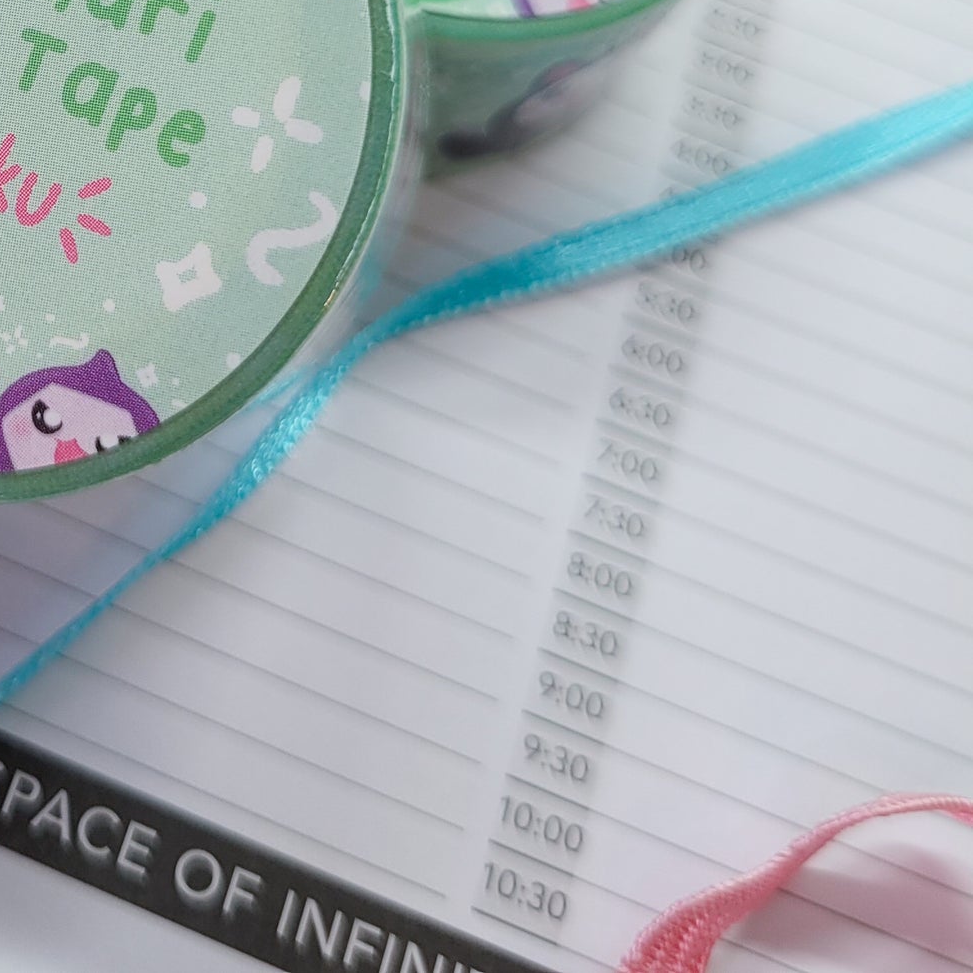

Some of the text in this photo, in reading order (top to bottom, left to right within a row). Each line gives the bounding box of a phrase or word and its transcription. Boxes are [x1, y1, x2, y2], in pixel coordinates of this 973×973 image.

[18, 27, 207, 167] Tape
[608, 386, 672, 428] 6:30
[597, 436, 659, 484] 7:00
[584, 492, 645, 539] 7:30
[566, 552, 633, 600] 8:00
[552, 610, 619, 659] 8:30
[537, 670, 605, 720] 9:00
[523, 733, 590, 785] 9:30
[499, 795, 585, 855] 10:00
[173, 847, 263, 915] OF
[276, 887, 489, 973] INFIN
[482, 861, 569, 922] 10:30
